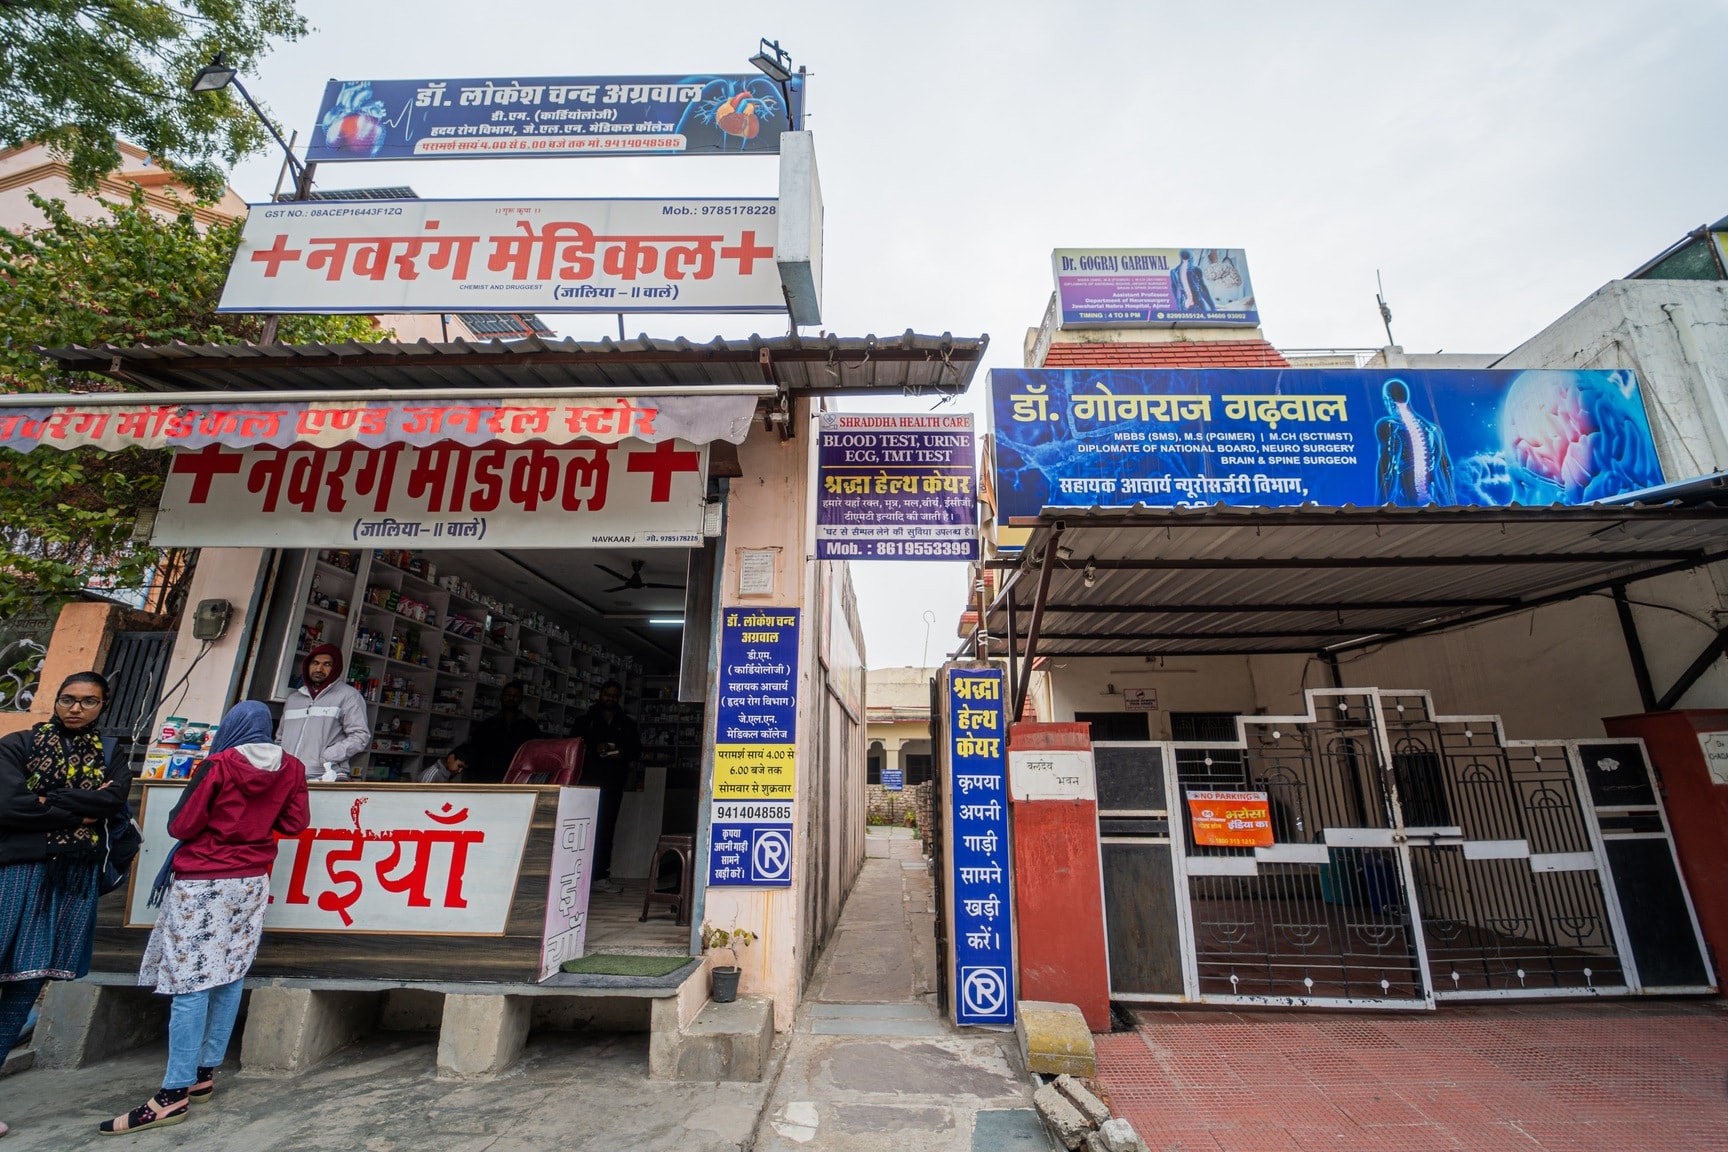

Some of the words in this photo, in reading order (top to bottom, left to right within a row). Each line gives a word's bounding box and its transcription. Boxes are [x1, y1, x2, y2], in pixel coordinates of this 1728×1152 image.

[415, 82, 451, 107] डॉ.
[460, 81, 546, 106] लोकेश
[549, 84, 601, 105] चन्द
[603, 83, 704, 104] अग्रवाल
[491, 110, 530, 123] डी.एम.
[457, 124, 477, 136] रोग
[589, 121, 633, 134] मेडिकल
[636, 120, 675, 133] कॉलेज
[265, 210, 286, 218] GST
[702, 206, 777, 215] 9785178228
[307, 219, 480, 281] नवरंग
[488, 219, 724, 281] मेडिकल
[1062, 256, 1077, 272] Dr.
[1080, 256, 1118, 273] GOGRAJ
[1121, 256, 1169, 271] GARHWAL
[1009, 384, 1058, 423] डॉ.
[1071, 382, 1211, 422] गोगराज
[1221, 394, 1347, 430] गढ़वाल
[402, 404, 557, 435] जनरल
[565, 398, 659, 435] स्टोर
[840, 416, 897, 428] SHRADDHA
[901, 416, 940, 428] HEALTH
[943, 416, 970, 428] CARE
[823, 434, 876, 448] BLOOD
[879, 434, 921, 449] TEST,
[923, 434, 970, 448] URINE
[1114, 432, 1145, 441] MBBS
[1148, 432, 1181, 443] (SMS),
[1205, 432, 1255, 443] (PGIMER)
[1269, 432, 1296, 441] M.CH
[1298, 432, 1352, 443] (SCTIMST)
[1078, 444, 1139, 453] DIPLOMATE
[1142, 444, 1157, 453] OF
[1160, 444, 1214, 453] NATIONAL
[1217, 444, 1259, 455] BOARD,
[1261, 444, 1300, 453] NEURO
[1302, 444, 1354, 453] SURGERY
[845, 450, 880, 463] ECG,
[882, 450, 916, 462] TMT
[917, 450, 953, 462] TEST
[1220, 456, 1255, 465] BRAIN
[1257, 456, 1266, 465] &
[1268, 456, 1300, 465] SPINE
[1302, 456, 1357, 465] SURGEON
[246, 442, 405, 512] नवरग
[824, 475, 872, 494] श्रद्धा
[874, 469, 920, 494] हेल्थ
[921, 469, 971, 494] केयर
[1059, 477, 1116, 494] सहायक
[1120, 473, 1171, 493] आचार्य
[1252, 473, 1308, 496] विभाग,
[822, 497, 843, 508] हमारे
[843, 511, 874, 523] टीएमटी
[907, 510, 919, 521] की
[920, 511, 942, 521] जाती
[841, 525, 849, 536] से
[876, 525, 889, 537] लेने
[893, 525, 903, 536] की
[592, 535, 630, 543] NAVKAAR
[876, 542, 971, 555] 8619553399
[727, 614, 741, 627] डॉ.
[743, 613, 775, 628] लोकेश
[776, 616, 795, 627] चन्द
[741, 631, 780, 644] अग्रवाल
[747, 649, 772, 662] डी.एम.
[728, 682, 759, 693] सहायक
[761, 680, 789, 692] आचार्य
[954, 677, 1001, 701] श्रद्धा
[747, 694, 761, 706] रोग
[762, 695, 789, 706] विभाग
[957, 704, 998, 730] हेल्थ
[726, 727, 759, 740] मेडिकल
[760, 727, 788, 740] कॉलेज
[955, 731, 1001, 758] केयर
[718, 747, 745, 760] परामर्श
[766, 751, 785, 760] 4.00
[787, 747, 795, 760] से
[730, 766, 749, 775] 6.00
[751, 762, 765, 775] बजे
[767, 765, 783, 775] तक
[719, 781, 749, 794] सोमवार
[751, 781, 759, 793] से
[761, 784, 791, 797] शुक्रवार
[957, 775, 1001, 795] कृपया
[717, 806, 791, 820] 9414048585
[959, 799, 1001, 821] अपनी
[1225, 807, 1266, 819] भरोसा
[722, 829, 741, 840] कृपया
[714, 840, 733, 852] अपनी
[962, 829, 998, 856] गाड़ी
[721, 853, 740, 865] सामने
[960, 860, 1002, 885] सामने
[963, 893, 1001, 921] खड़ी
